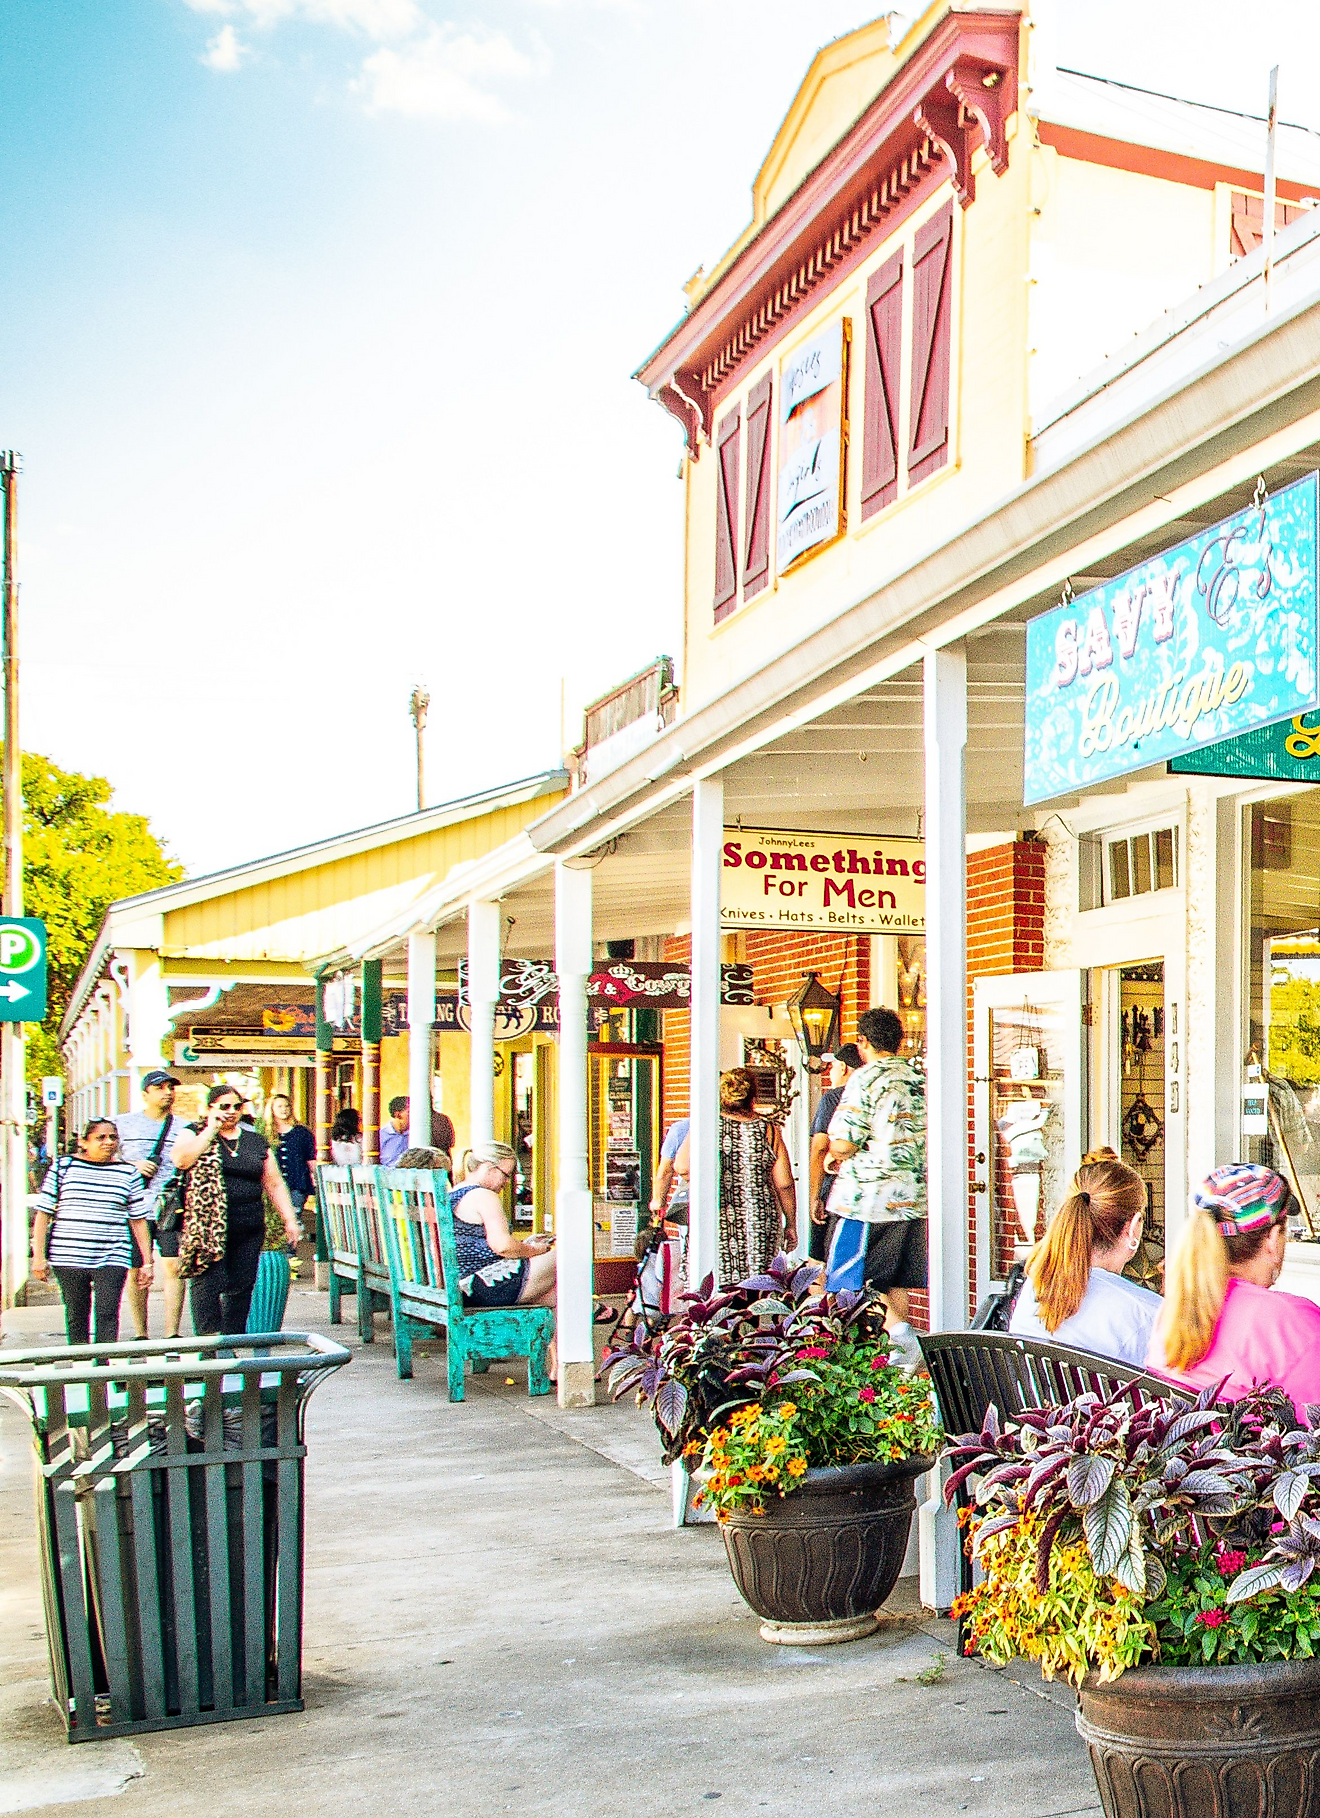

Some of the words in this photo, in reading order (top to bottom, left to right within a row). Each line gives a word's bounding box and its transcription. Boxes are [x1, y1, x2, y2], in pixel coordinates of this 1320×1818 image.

[1055, 569, 1181, 688] SAVY
[1078, 662, 1249, 759] Boutique
[758, 836, 815, 850] JohnnyLees
[723, 841, 926, 884] Something
[764, 874, 808, 897] For
[823, 877, 897, 909] Men
[778, 909, 814, 922] Hats
[828, 911, 865, 924] Belts
[1, 933, 27, 965] P
[603, 982, 617, 995] &
